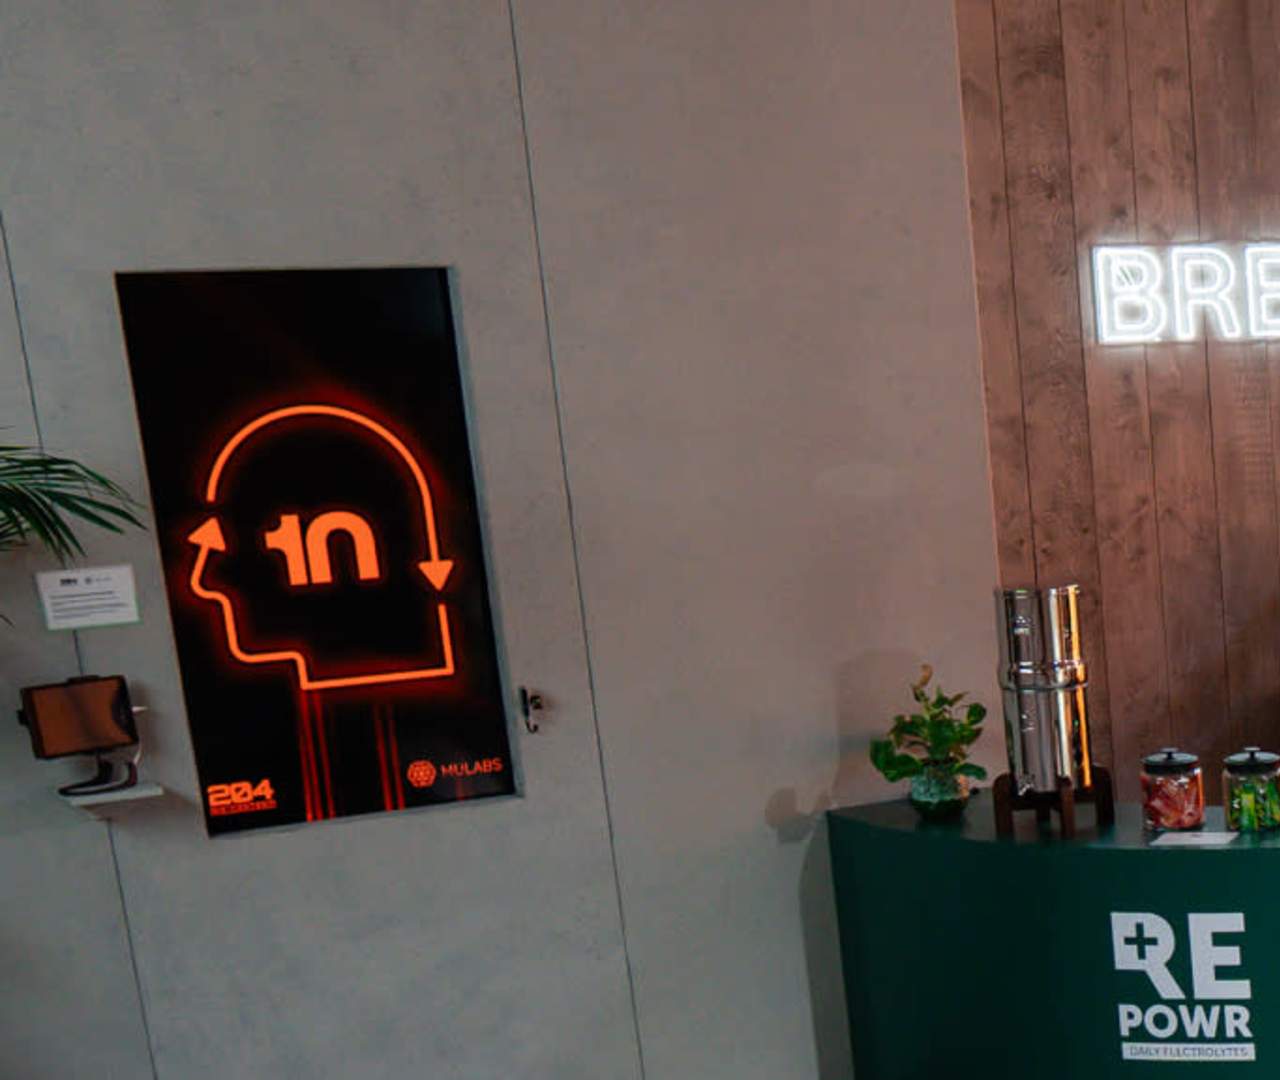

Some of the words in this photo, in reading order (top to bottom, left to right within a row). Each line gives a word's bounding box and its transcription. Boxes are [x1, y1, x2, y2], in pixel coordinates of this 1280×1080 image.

[441, 757, 503, 777] MULABS
[207, 779, 274, 806] 204
[1110, 911, 1252, 1000] RE
[1118, 1004, 1254, 1039] POWR
